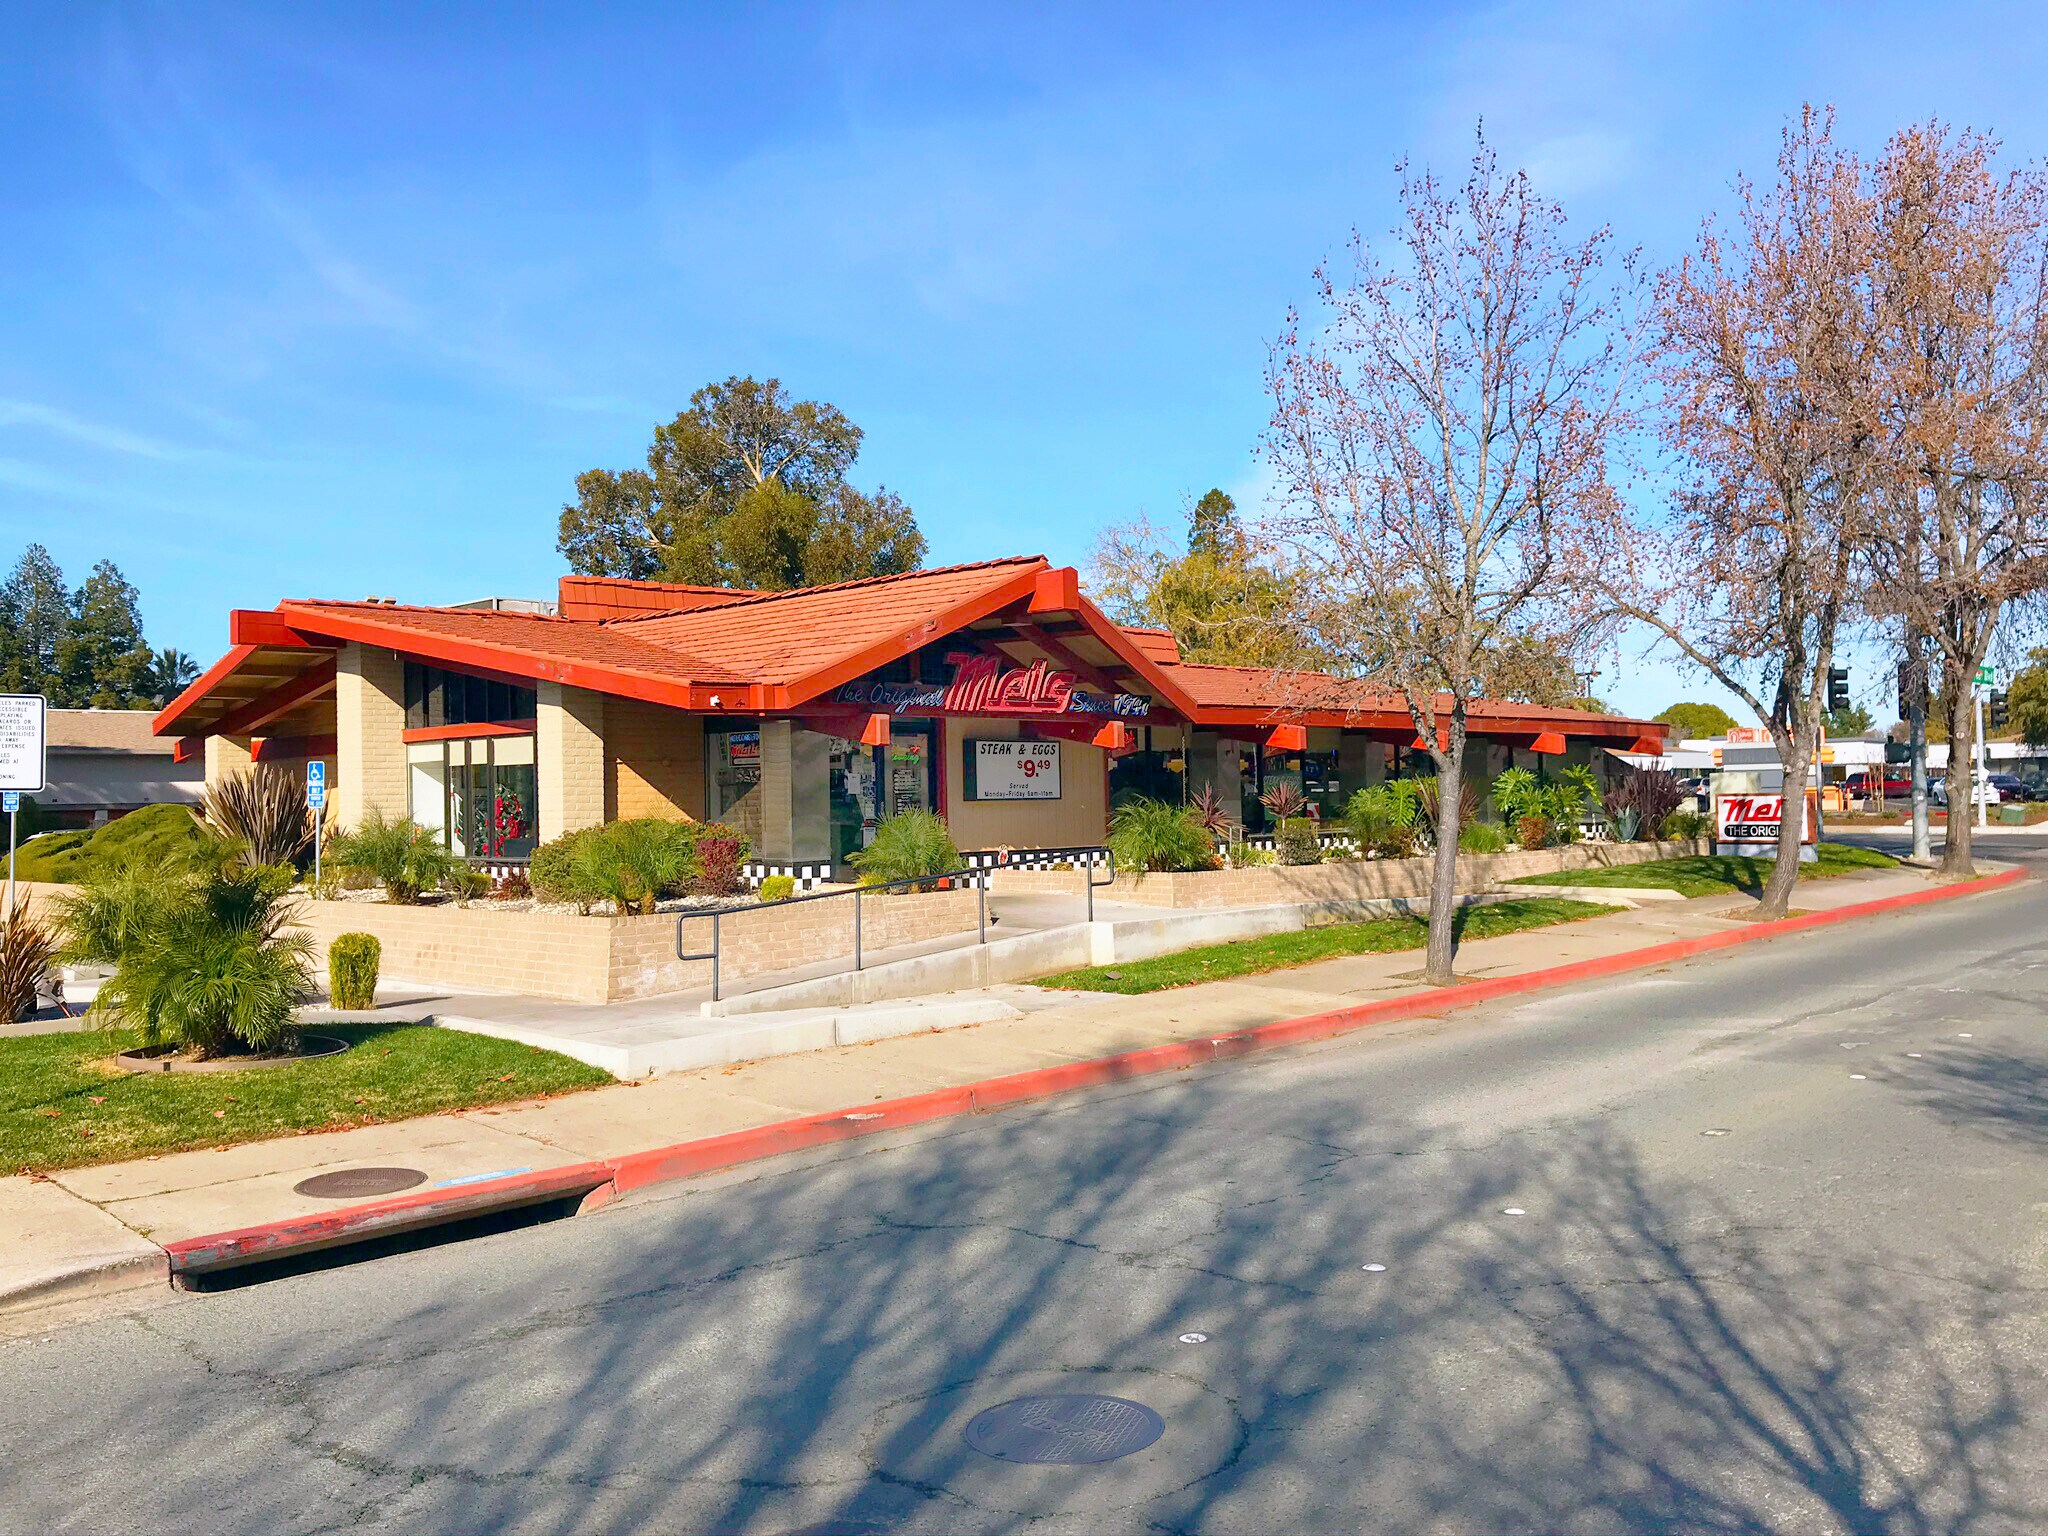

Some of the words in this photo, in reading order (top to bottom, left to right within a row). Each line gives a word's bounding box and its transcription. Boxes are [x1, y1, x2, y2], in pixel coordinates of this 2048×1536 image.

[870, 683, 944, 714] Original
[1069, 692, 1110, 712] Since
[981, 743, 1013, 755] STEAK
[1018, 744, 1026, 755] &
[1032, 744, 1056, 755] EGGS
[1017, 759, 1051, 778] $9.49
[1723, 799, 1784, 822] Mel
[1728, 826, 1748, 836] THE
[1750, 826, 1779, 836] ORIGI
